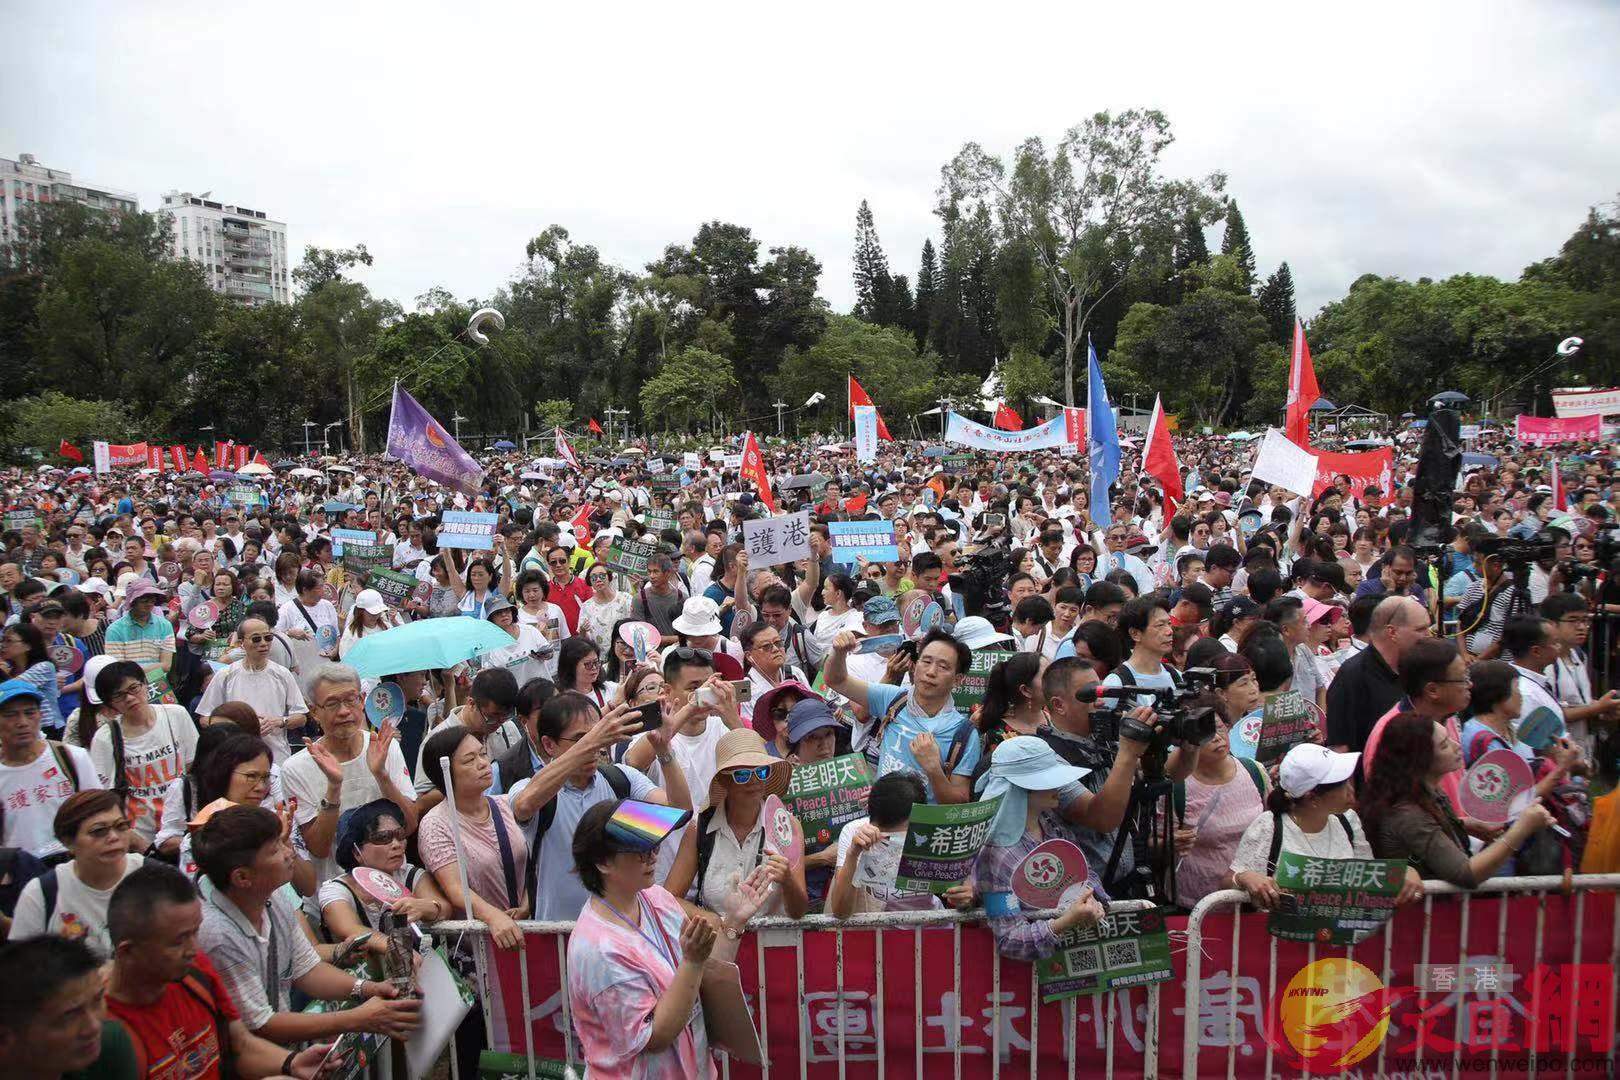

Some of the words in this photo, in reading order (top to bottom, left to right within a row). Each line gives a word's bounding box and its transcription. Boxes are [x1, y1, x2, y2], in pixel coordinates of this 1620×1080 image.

[749, 518, 808, 556] 護港
[351, 545, 385, 558] 希望明天
[621, 539, 657, 558] 希望明天
[377, 577, 411, 597] 希望明天
[145, 744, 174, 762] MAKE
[787, 757, 857, 795] 希望明天
[796, 794, 827, 813] Peace
[829, 790, 838, 806] A
[914, 868, 933, 878] Give
[934, 870, 958, 880] Peace
[1303, 858, 1387, 889] 希望明天
[1307, 891, 1342, 906] Peace
[1345, 890, 1353, 906] A
